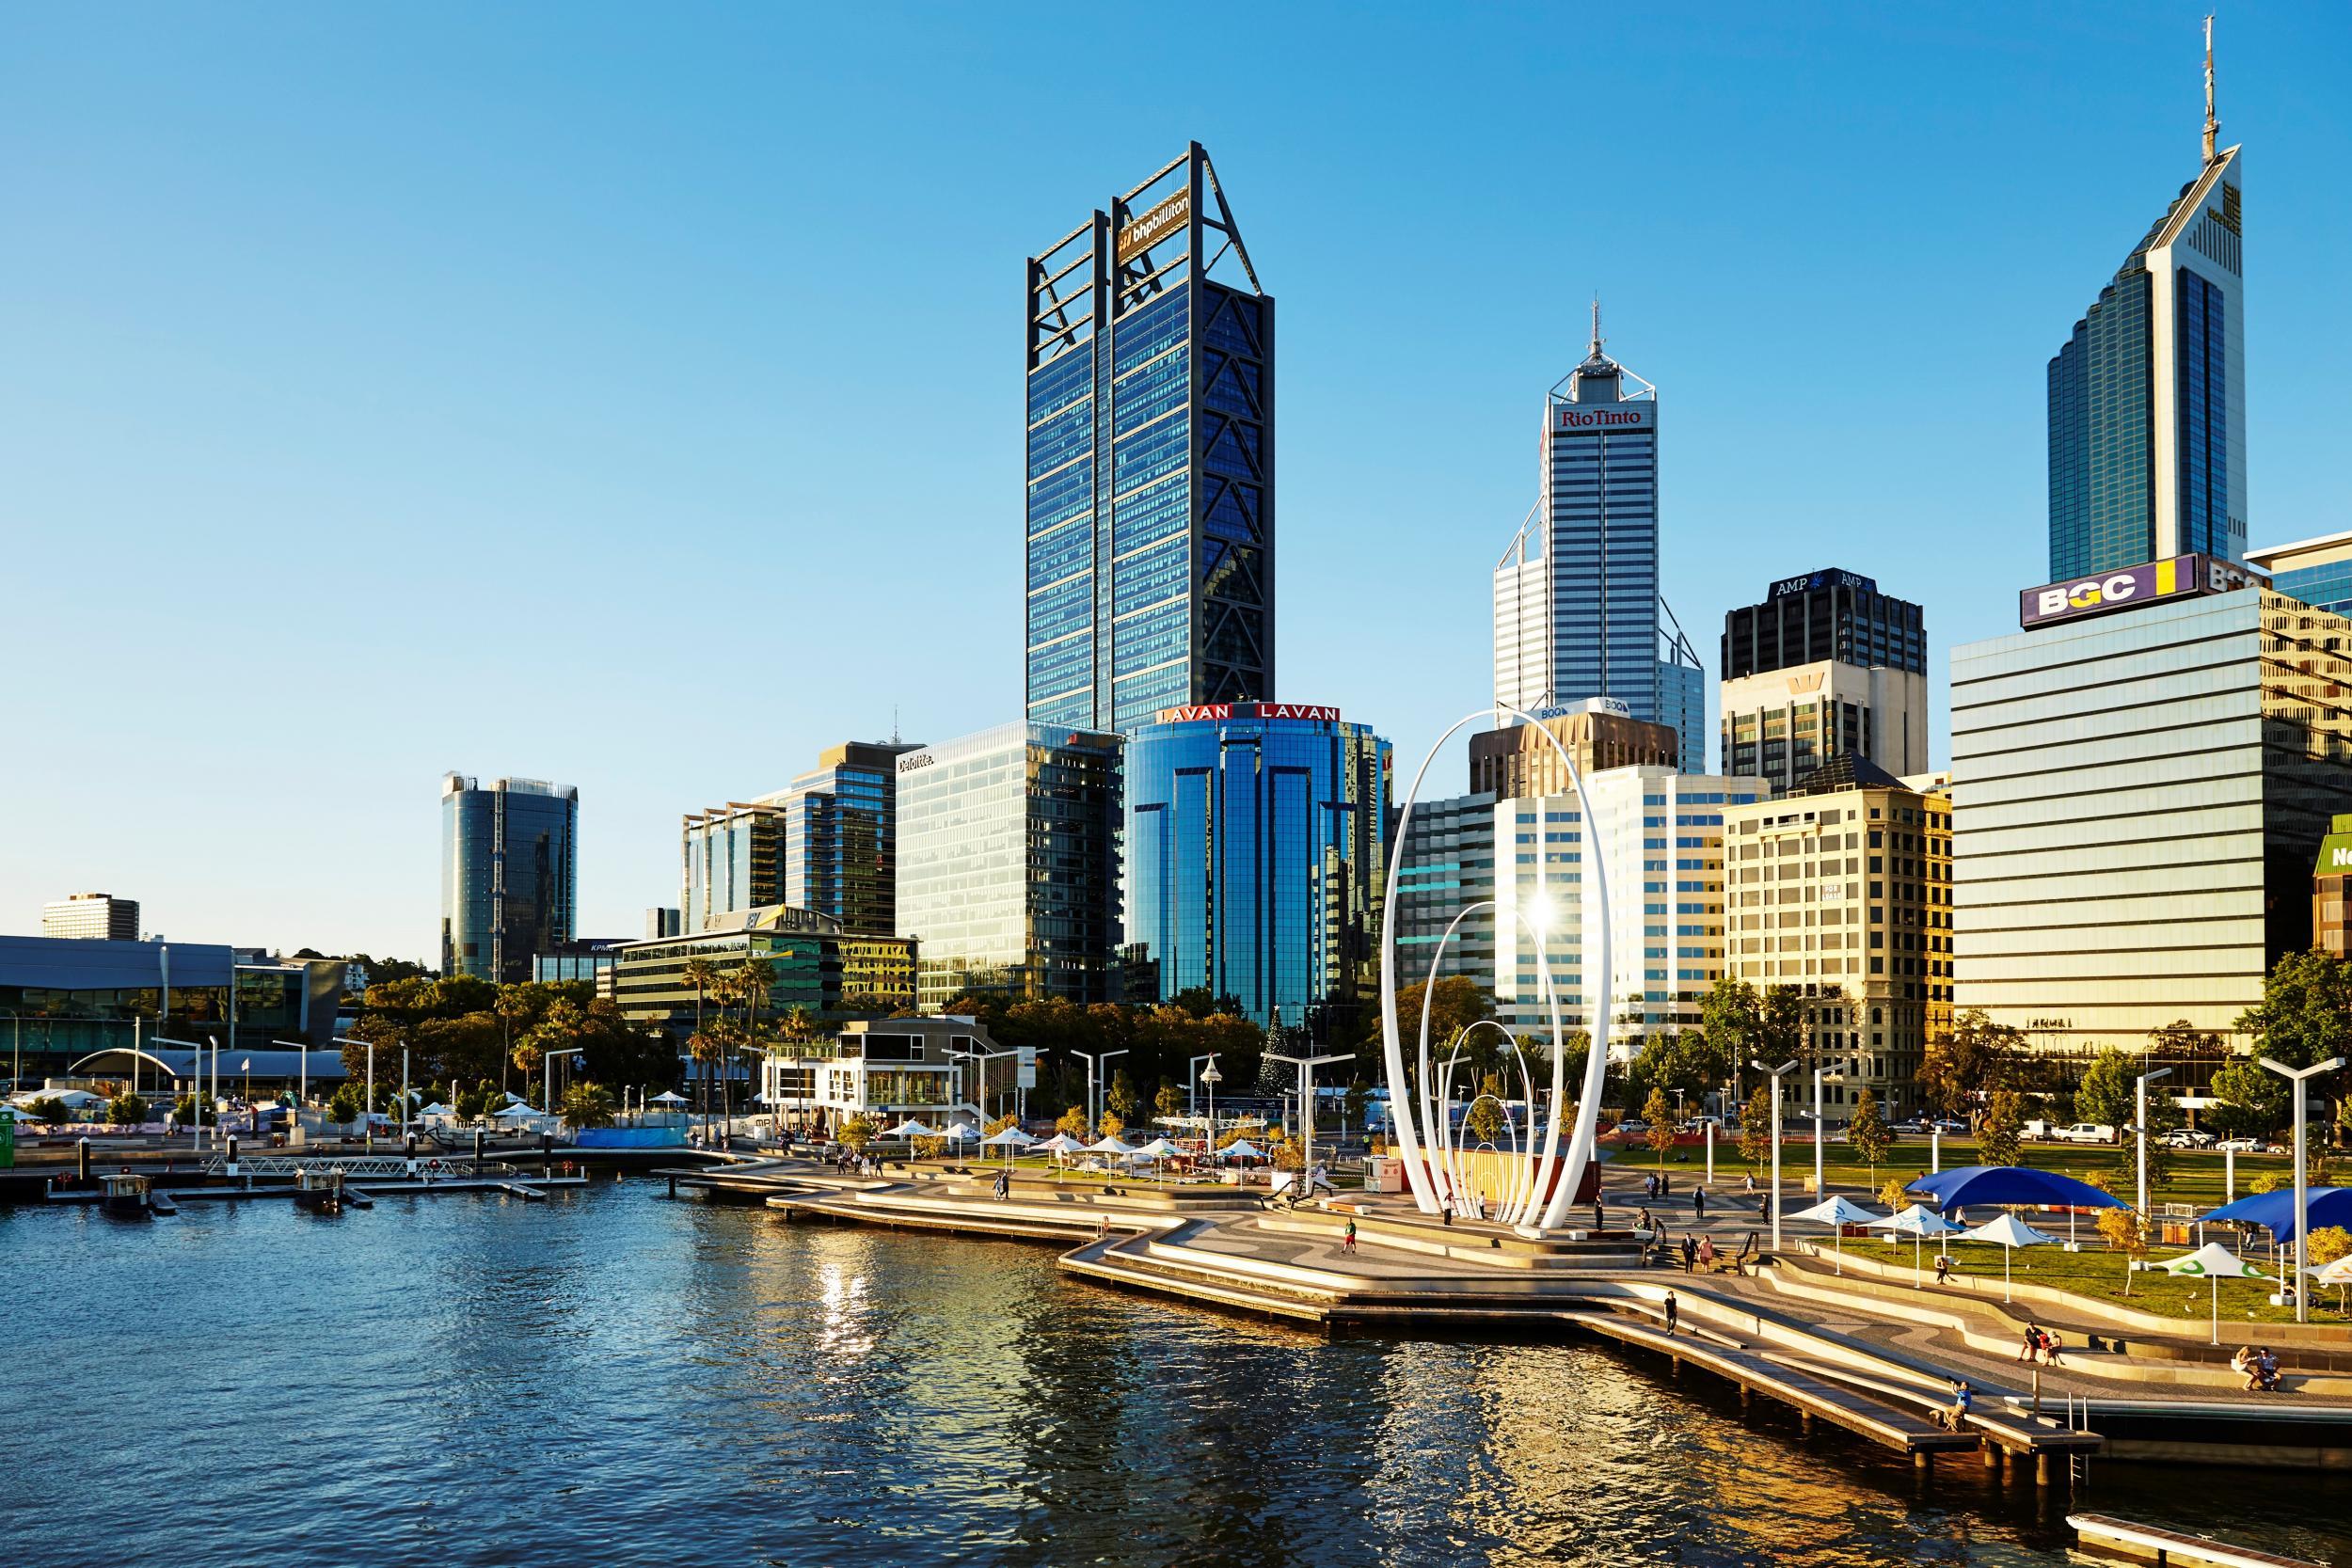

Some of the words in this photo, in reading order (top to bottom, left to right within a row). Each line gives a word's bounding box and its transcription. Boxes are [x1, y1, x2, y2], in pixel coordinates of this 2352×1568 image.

[1776, 578, 1807, 595] AMP
[1841, 573, 1861, 588] AMP
[2039, 575, 2136, 616] BGC
[1161, 705, 1229, 722] LAVAN
[1261, 705, 1336, 721] LAVAN
[1542, 706, 1562, 720] BOQ
[1605, 700, 1624, 712] BOQ
[753, 950, 767, 958] EY
[755, 1118, 773, 1127] MR
